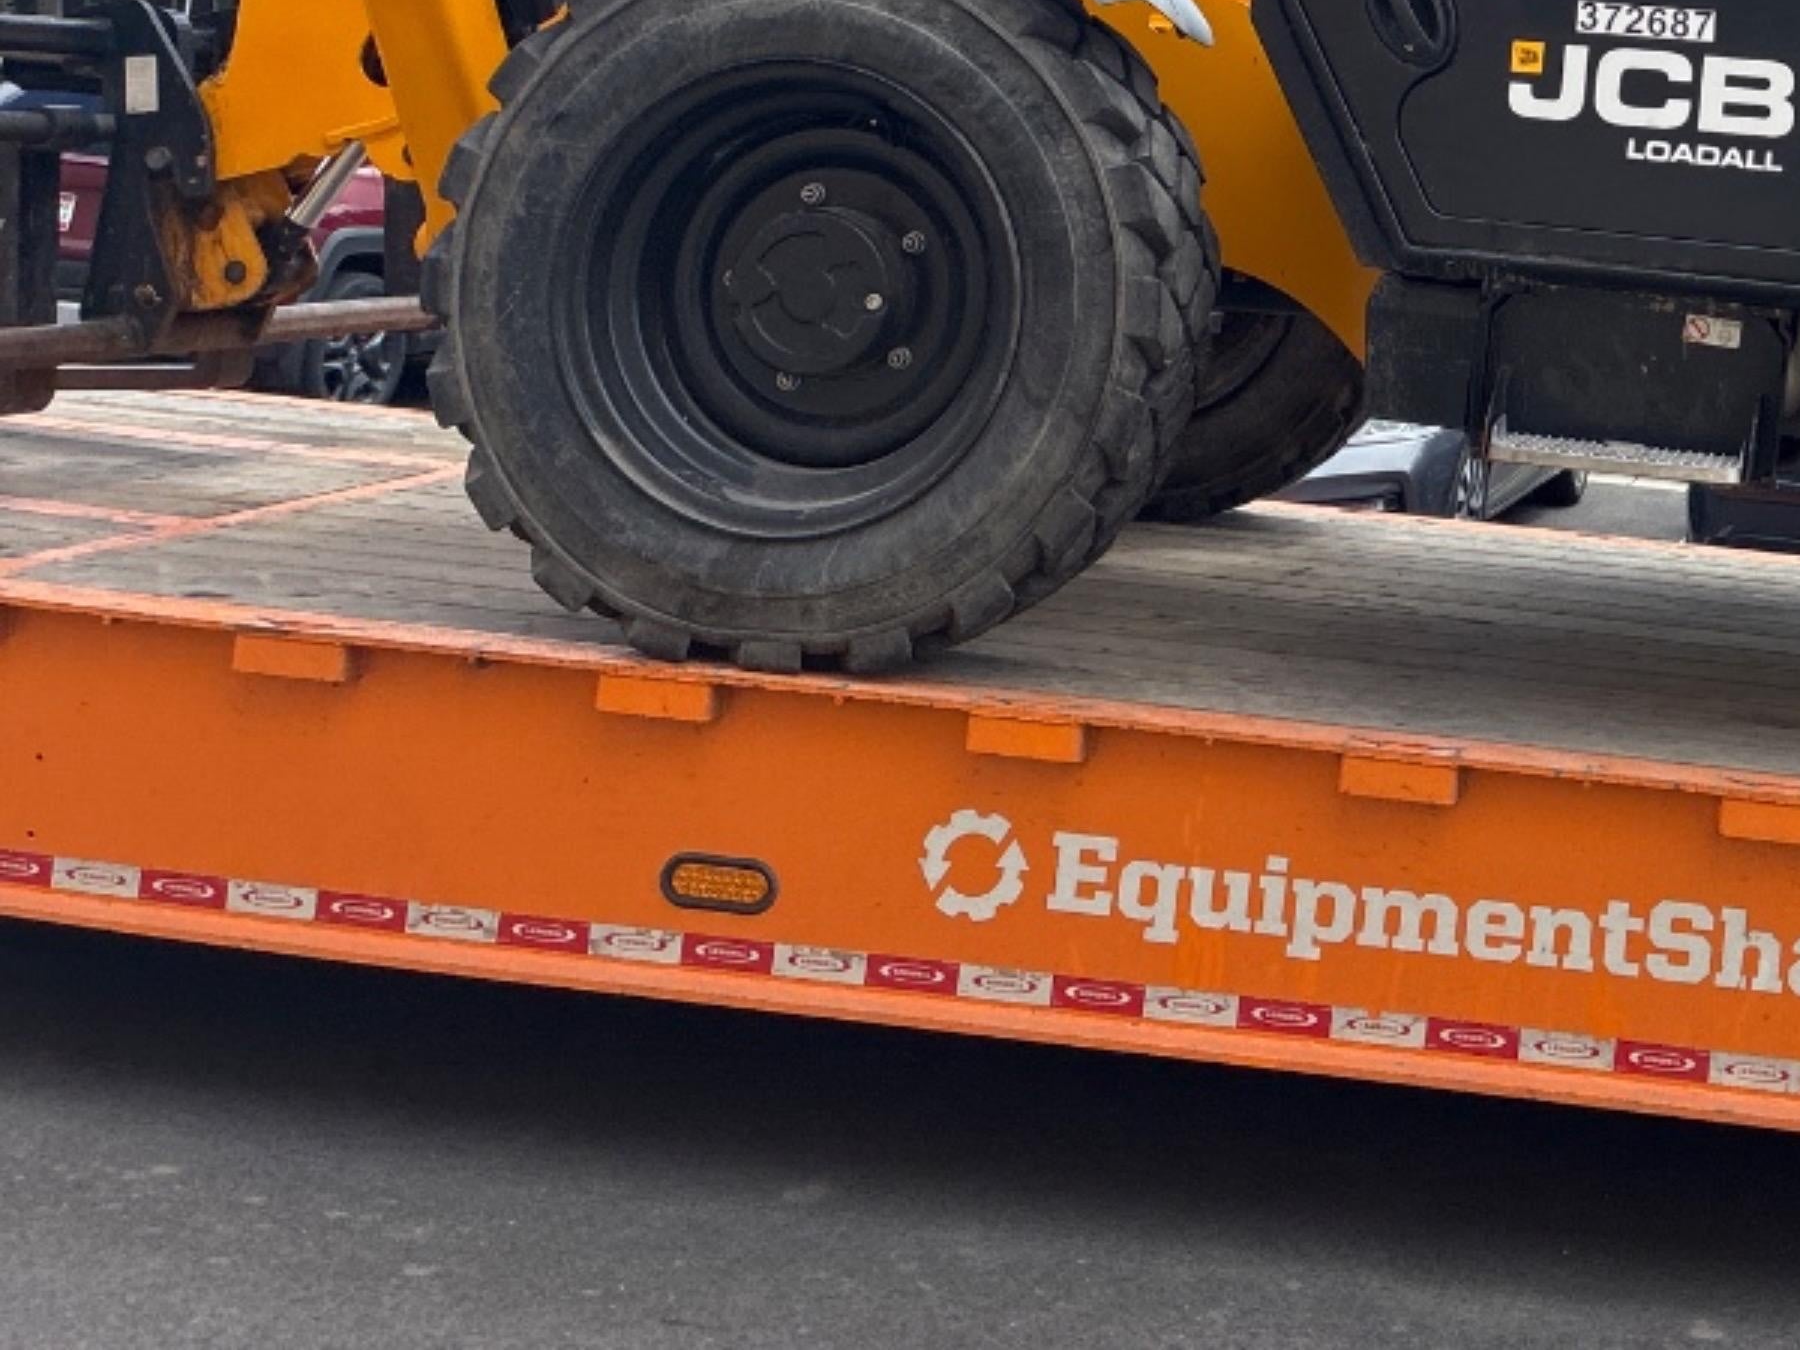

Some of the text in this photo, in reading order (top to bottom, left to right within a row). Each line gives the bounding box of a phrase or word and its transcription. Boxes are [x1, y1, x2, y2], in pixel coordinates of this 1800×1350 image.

[1579, 2, 1712, 39] 372687
[1508, 43, 1795, 139] JCB
[1625, 137, 1783, 172] LOADALL
